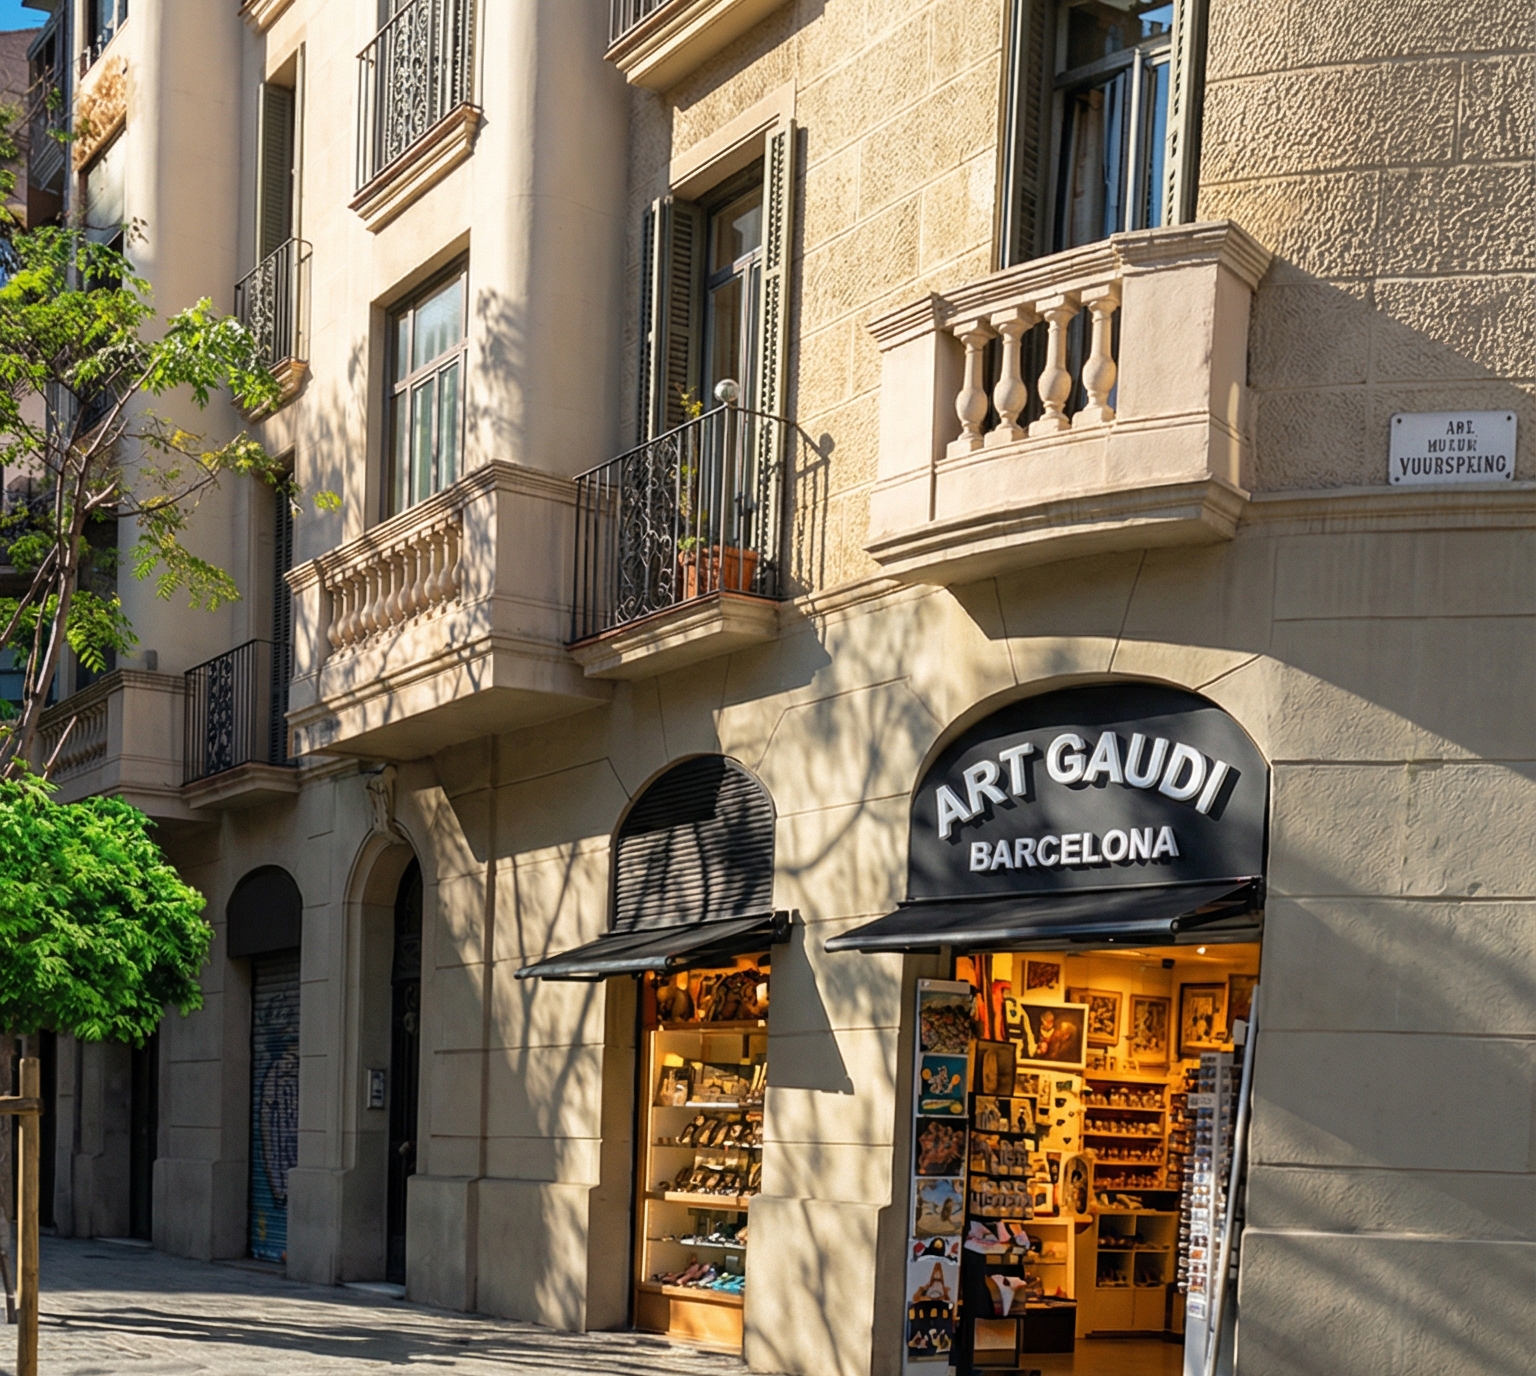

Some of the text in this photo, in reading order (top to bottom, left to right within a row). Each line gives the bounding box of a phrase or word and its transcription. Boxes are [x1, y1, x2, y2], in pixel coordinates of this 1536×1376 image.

[936, 731, 1230, 840] ART GAUDI
[969, 825, 1180, 872] BARCELONA
